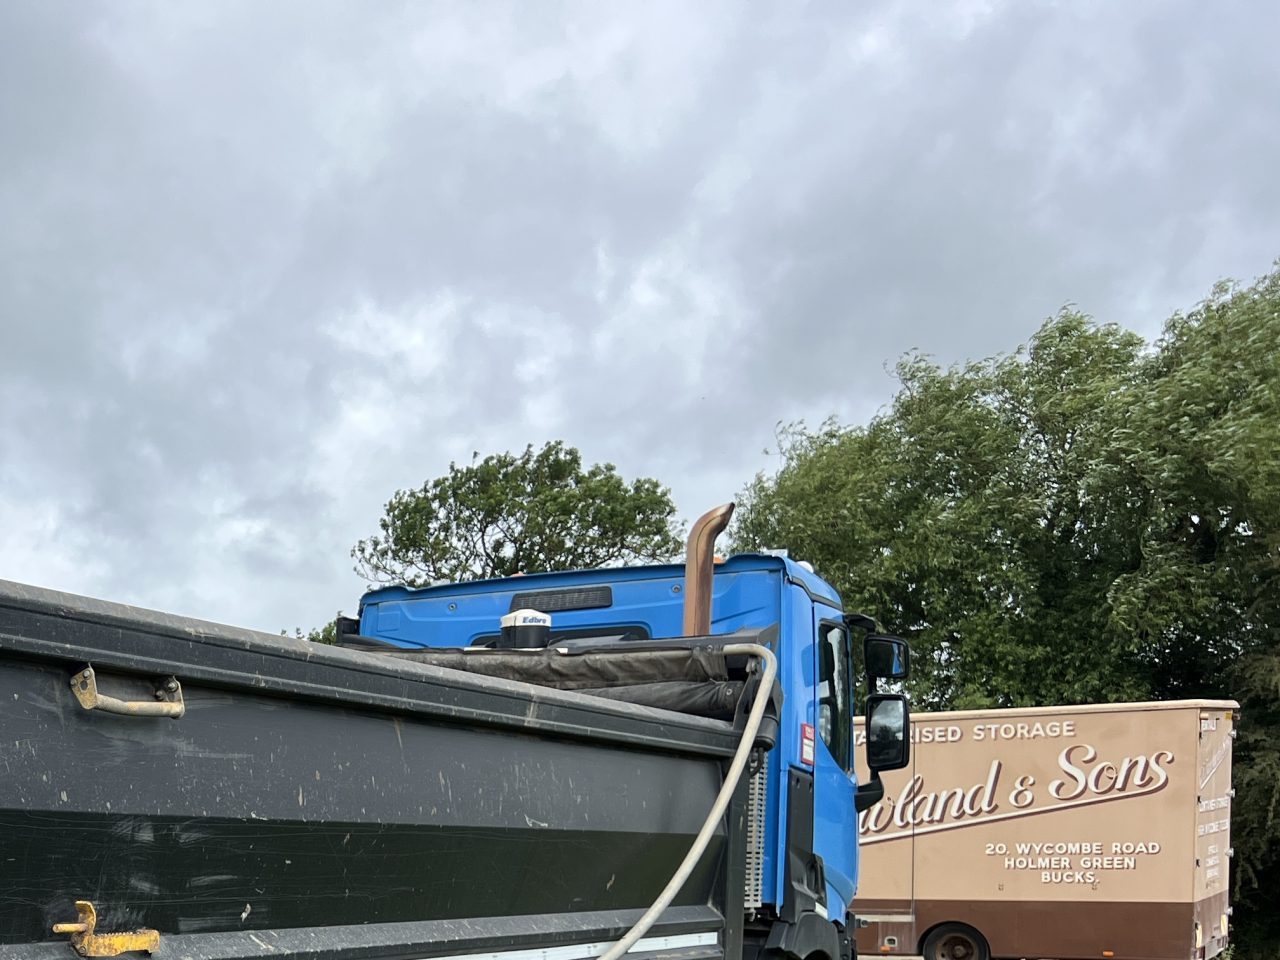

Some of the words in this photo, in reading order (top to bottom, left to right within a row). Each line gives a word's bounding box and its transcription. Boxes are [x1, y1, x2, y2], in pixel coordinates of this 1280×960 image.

[972, 720, 1076, 741] STORAGE
[858, 759, 1003, 835] wland
[1008, 774, 1036, 808] &
[1047, 743, 1175, 801] Sons
[1015, 842, 1104, 856] WYCOMBE
[1111, 842, 1162, 855] ROAD
[1004, 857, 1072, 870] HOLMER
[1080, 856, 1137, 870] GREEN
[1041, 871, 1101, 884] BUCKS.
